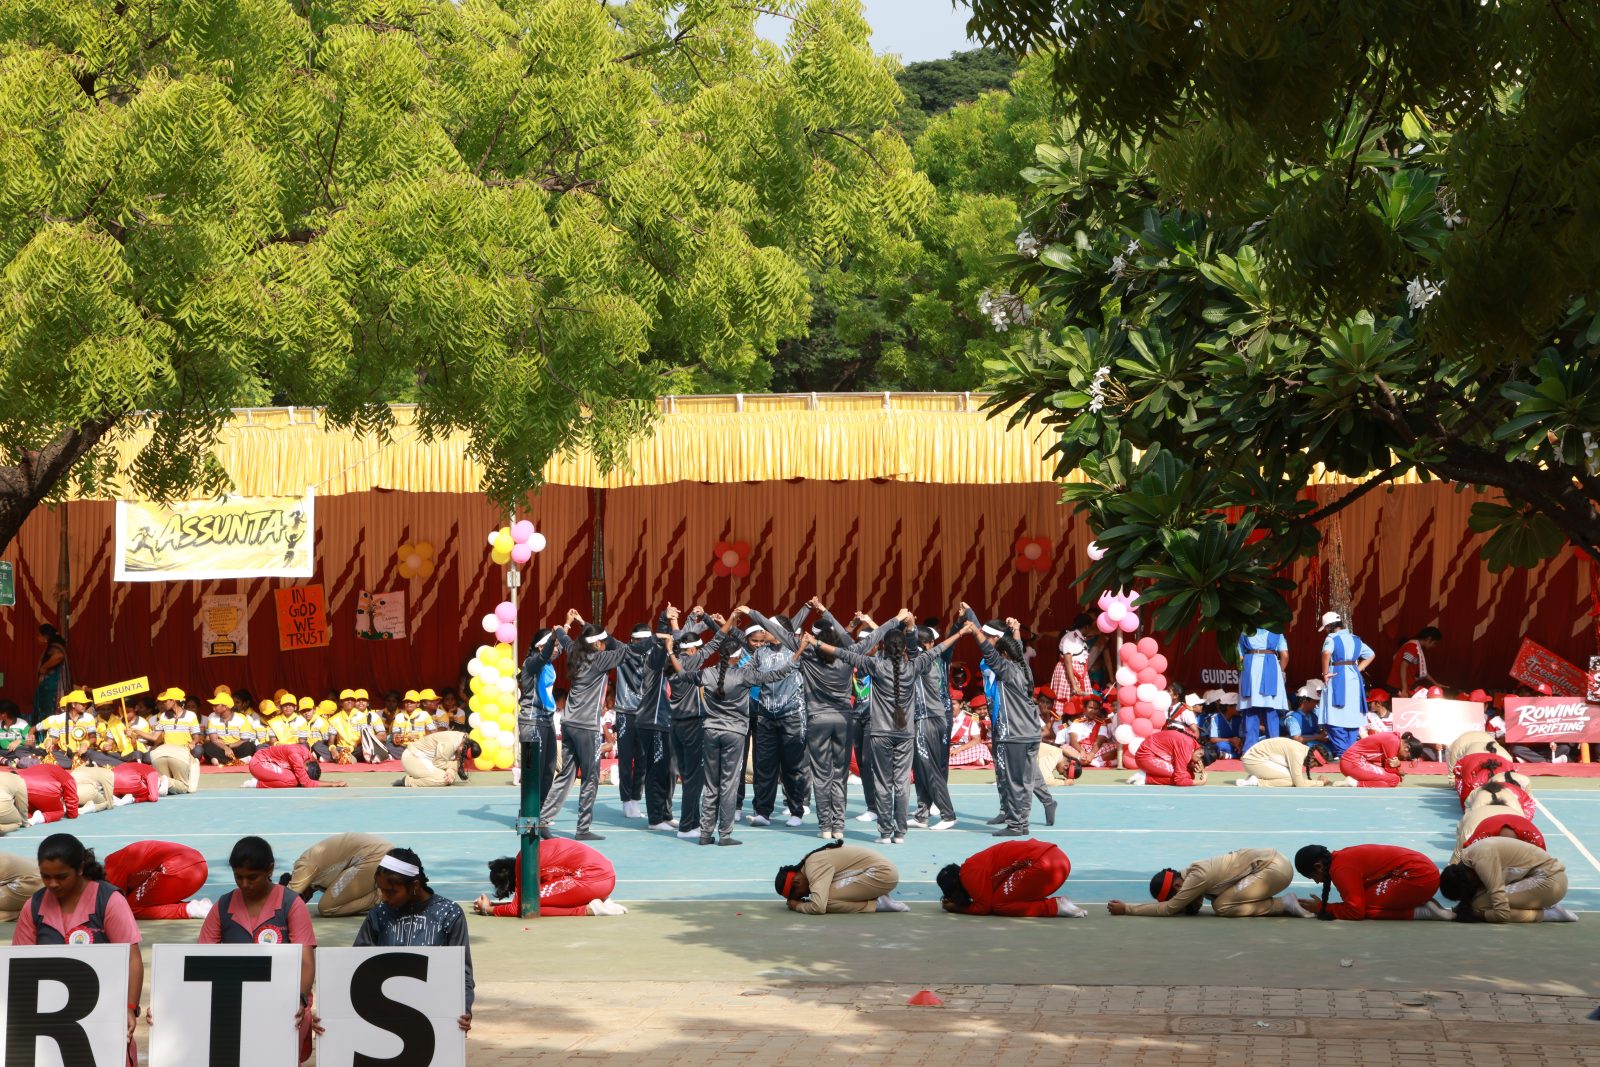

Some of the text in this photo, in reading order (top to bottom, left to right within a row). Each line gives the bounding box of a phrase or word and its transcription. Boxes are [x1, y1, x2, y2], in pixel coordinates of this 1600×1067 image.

[156, 509, 287, 552] ASSUNTA
[291, 588, 306, 604] IN
[289, 602, 317, 618] GOD
[293, 617, 316, 632] WE
[286, 630, 324, 647] TRUST
[1202, 669, 1239, 684] GUIDES
[100, 682, 143, 699] ASSUNTA
[1515, 703, 1589, 724] ROWING
[1525, 721, 1586, 736] DRIFTING
[5, 957, 100, 1067] R
[184, 956, 273, 1067] T
[350, 952, 436, 1067] S
